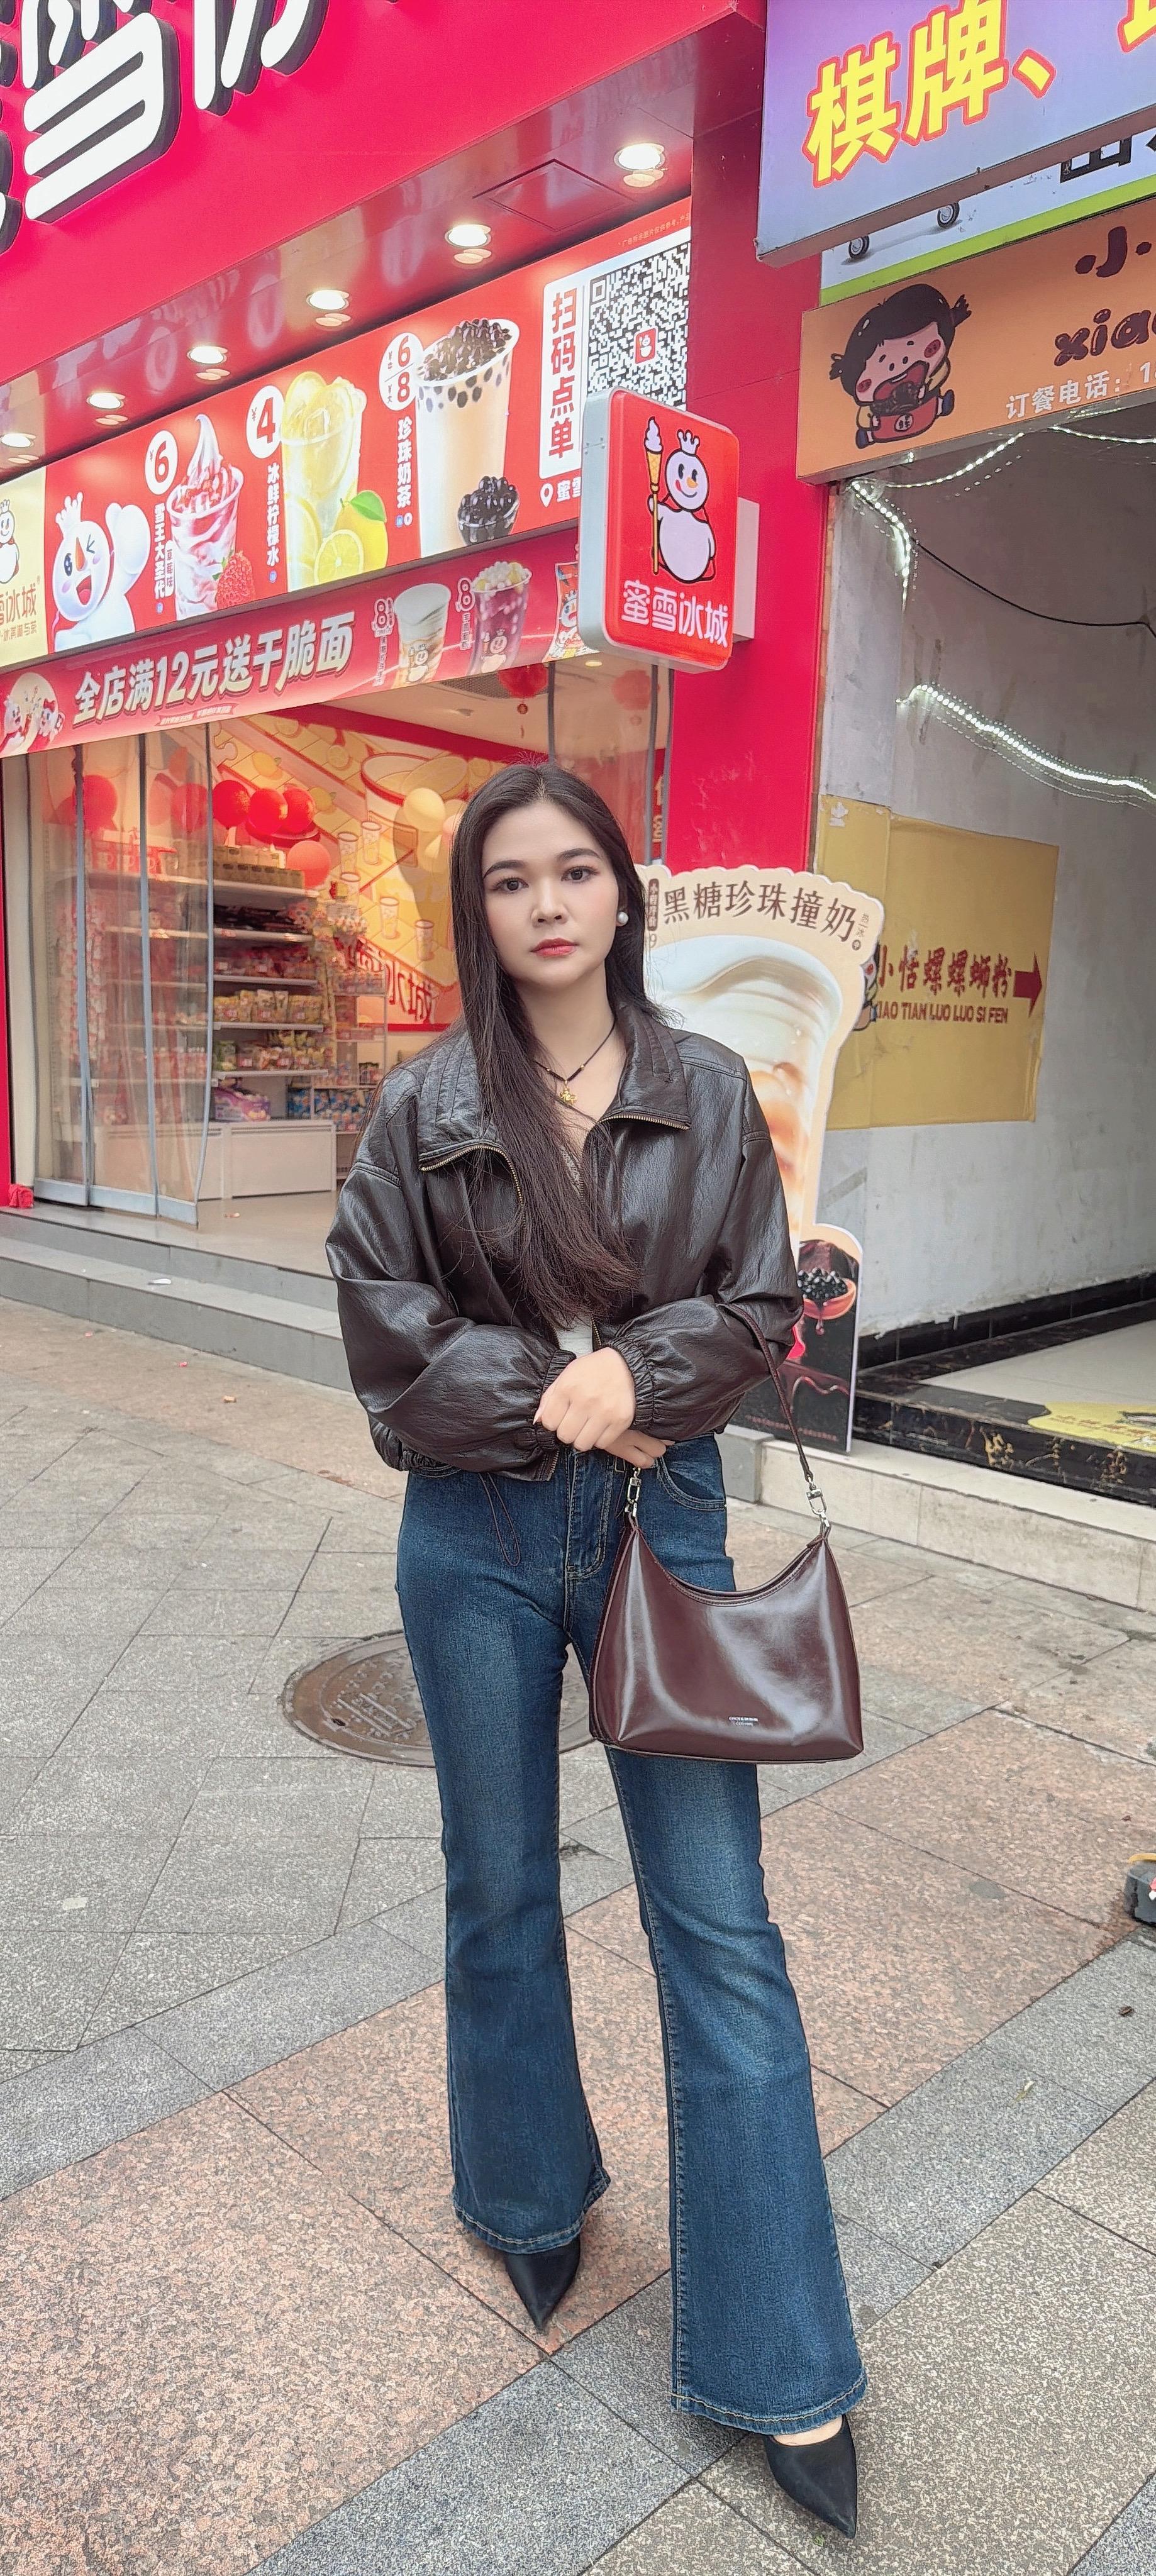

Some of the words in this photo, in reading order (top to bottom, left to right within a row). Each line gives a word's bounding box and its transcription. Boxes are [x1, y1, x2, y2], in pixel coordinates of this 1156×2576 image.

[806, 0, 1156, 184] 棋牌、
[397, 335, 410, 367] 6
[1054, 308, 1156, 367] xia
[397, 372, 410, 402] 8
[549, 287, 577, 458] 扫码点单
[1140, 362, 1156, 384] 1
[397, 416, 413, 509] 珍珠奶茶
[267, 462, 280, 567] 冰鲜柠檬水
[154, 502, 165, 599] 雪王大圣代
[621, 579, 728, 648] 蜜雪冰城
[72, 611, 355, 726] 全店满12元送干脆面
[664, 880, 857, 943] 黑糖珍珠撞奶
[901, 1002, 927, 1020] TIAN
[930, 1003, 950, 1021] LUO
[953, 1004, 974, 1022] LUO
[976, 1006, 986, 1023] SI
[988, 1007, 1008, 1023] FEN
